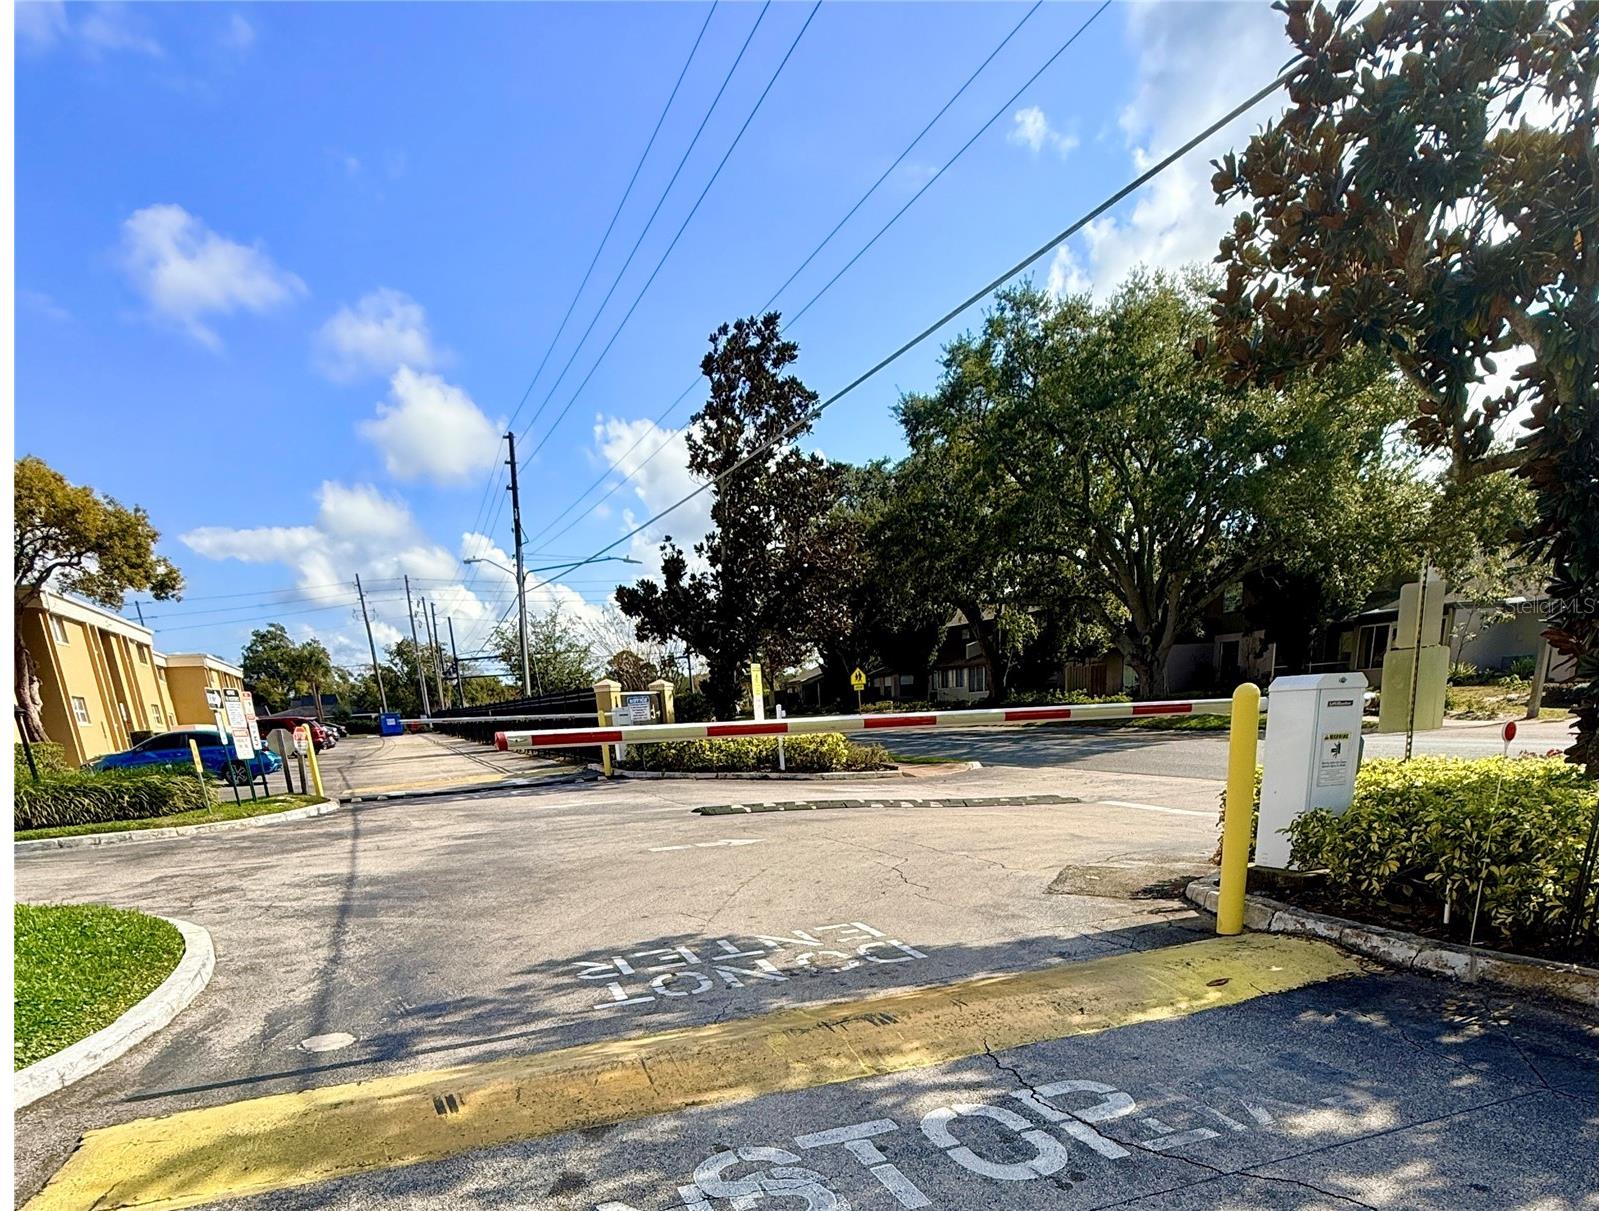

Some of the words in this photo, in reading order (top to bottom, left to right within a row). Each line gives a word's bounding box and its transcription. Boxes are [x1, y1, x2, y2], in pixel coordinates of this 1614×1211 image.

[571, 921, 887, 980] ENTER
[593, 958, 790, 1010] NOT
[692, 1079, 1136, 1211] STOP
